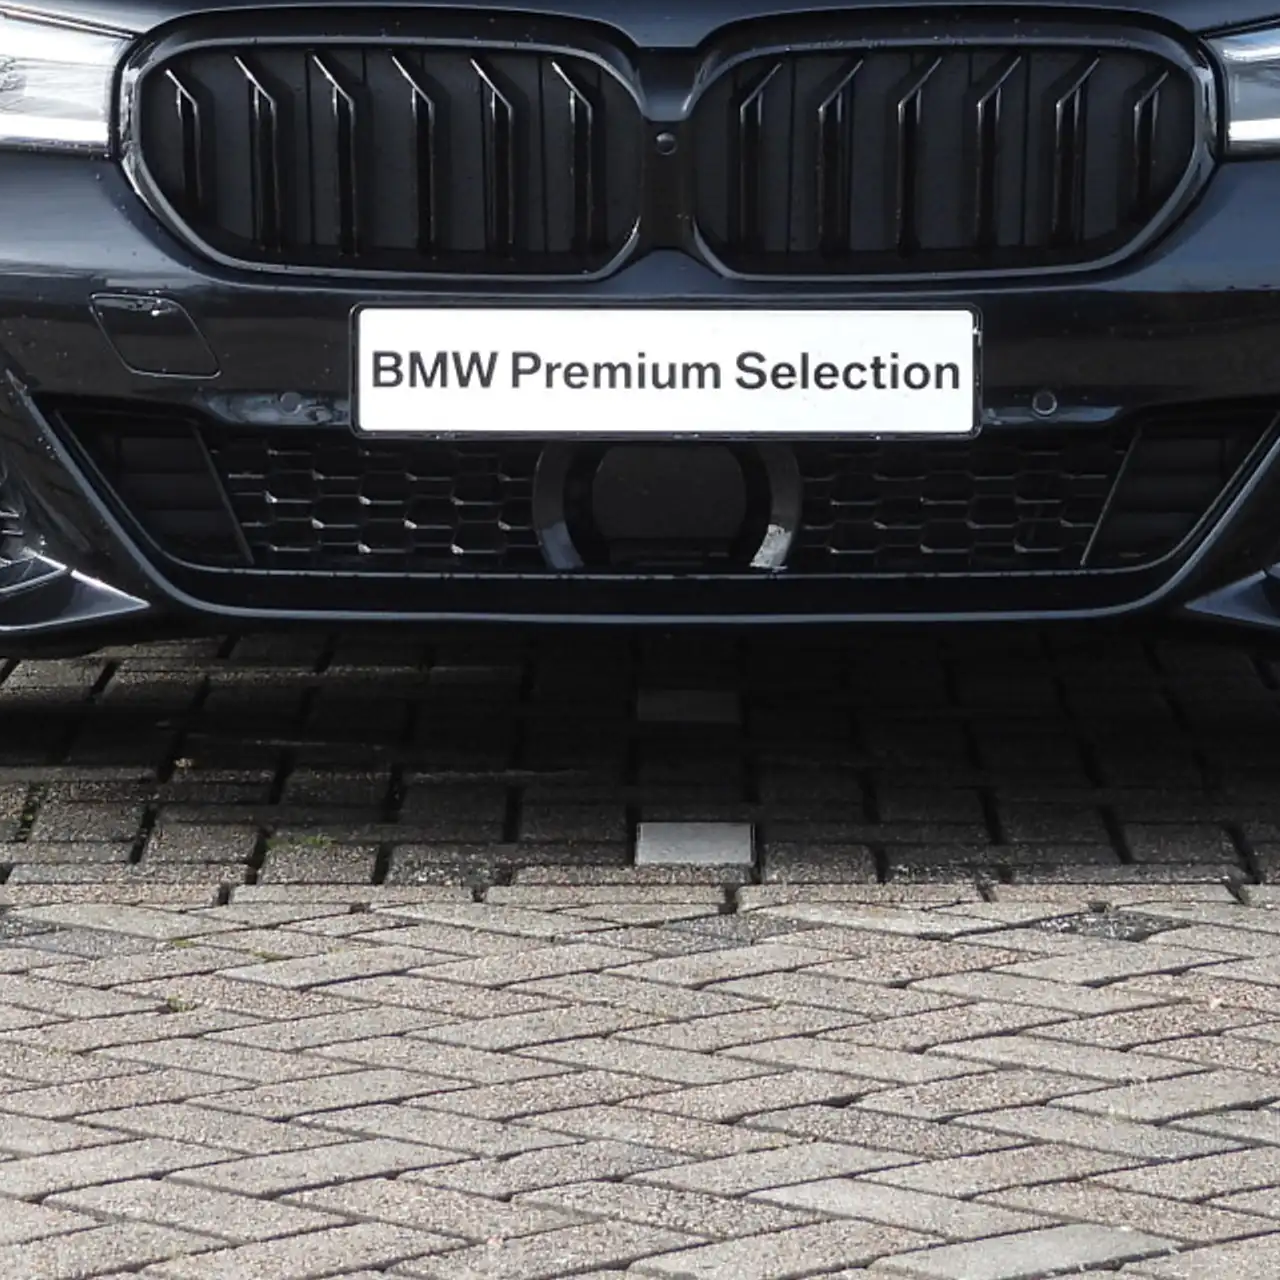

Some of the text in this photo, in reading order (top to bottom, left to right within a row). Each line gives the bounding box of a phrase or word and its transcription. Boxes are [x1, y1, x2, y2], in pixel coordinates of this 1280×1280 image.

[373, 352, 959, 390] BMW Premium Selection
